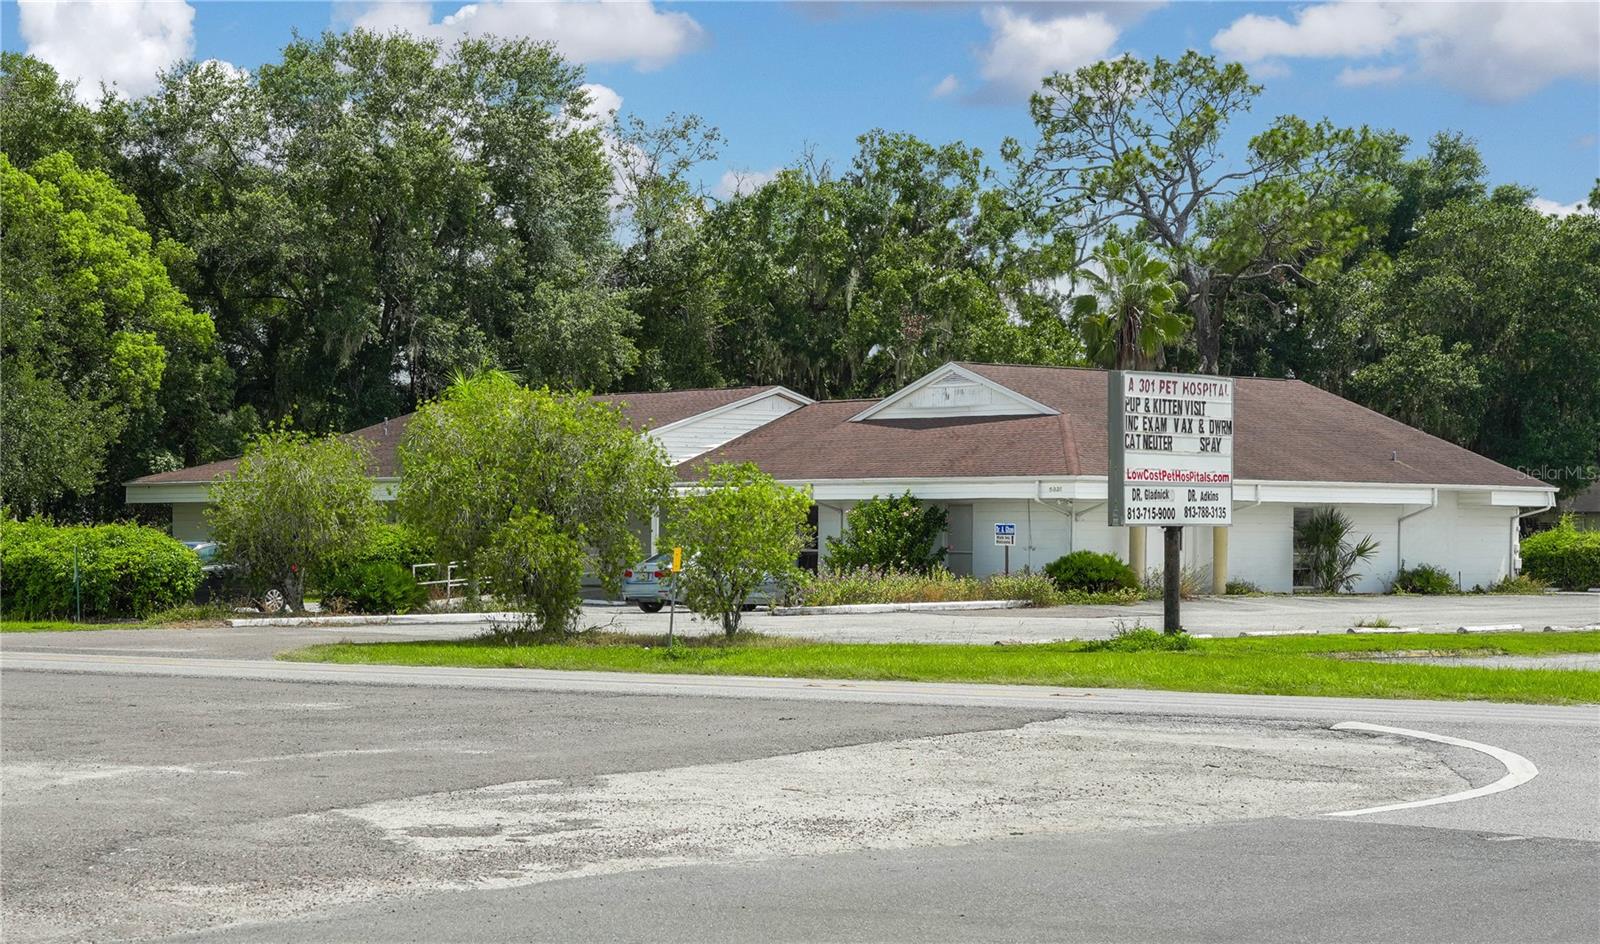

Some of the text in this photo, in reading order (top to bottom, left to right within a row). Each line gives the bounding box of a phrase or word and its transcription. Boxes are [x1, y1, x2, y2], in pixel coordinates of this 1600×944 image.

[1129, 378, 1134, 392] A
[1139, 379, 1155, 393] 301
[1159, 380, 1178, 394] PET
[1125, 397, 1206, 416] PUP & KITTEN VISIT
[1125, 415, 1232, 435] INC EXAM VAX & DWRM
[1125, 434, 1221, 453] CAT NEUTER SPAY
[1132, 488, 1169, 502] DR. Gladnick
[1188, 489, 1219, 502] DR. Adkins
[1127, 507, 1176, 520] 813-715-9000
[1184, 506, 1226, 518] 813-788-3135
